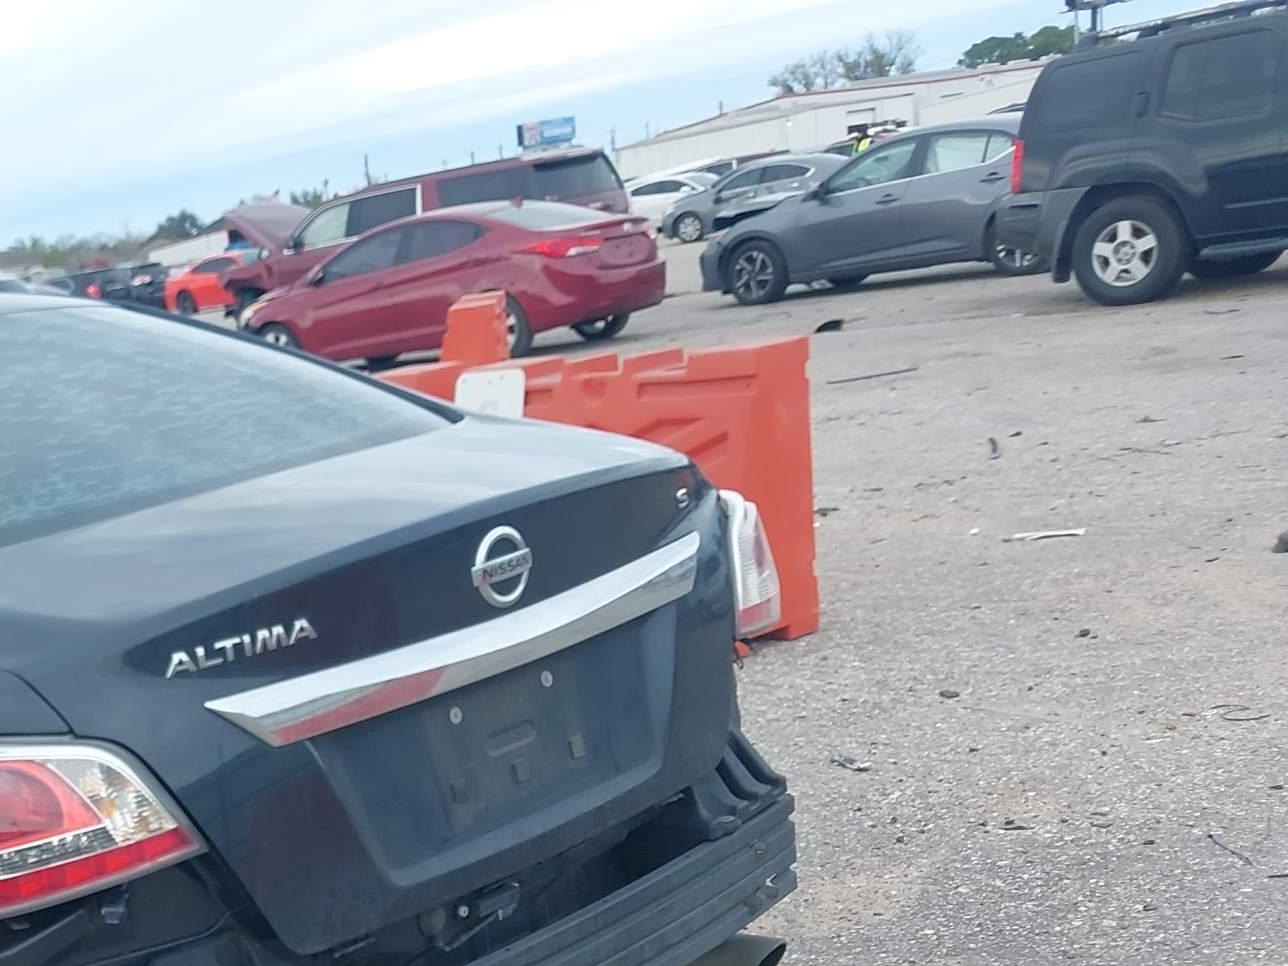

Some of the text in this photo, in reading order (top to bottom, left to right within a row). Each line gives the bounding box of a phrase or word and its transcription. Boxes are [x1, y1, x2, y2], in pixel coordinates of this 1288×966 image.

[675, 487, 689, 508] S
[481, 554, 530, 581] NISSAN
[165, 617, 318, 680] ALTIMA
